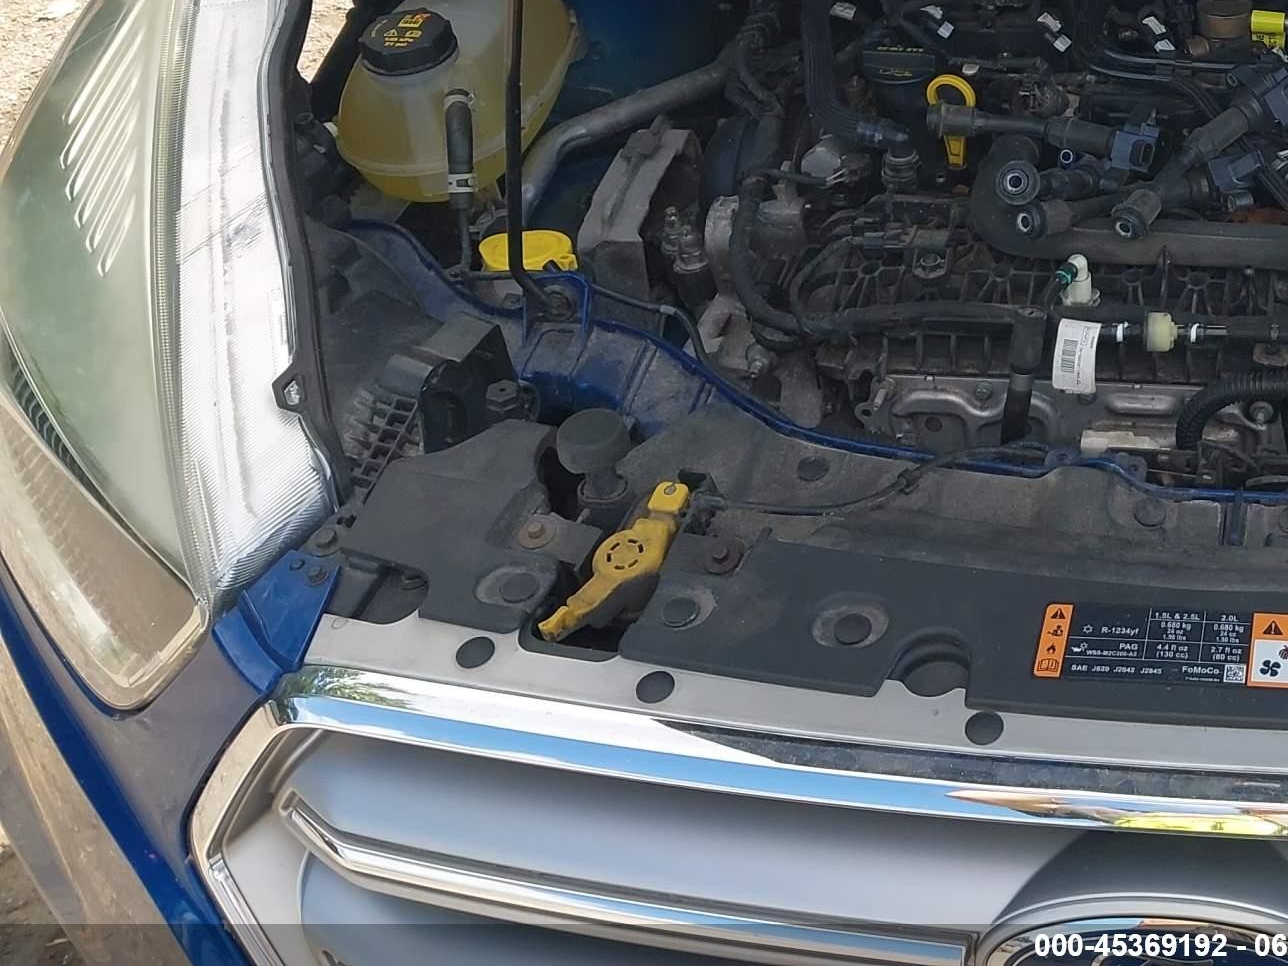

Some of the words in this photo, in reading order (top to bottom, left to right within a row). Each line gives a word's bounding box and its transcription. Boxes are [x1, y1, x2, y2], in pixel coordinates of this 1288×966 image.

[1182, 622, 1191, 630] kg
[1235, 625, 1244, 633] kg
[1101, 626, 1139, 636] R-1234yf
[1176, 652, 1188, 660] cc)
[1182, 666, 1220, 674] FoMoCo
